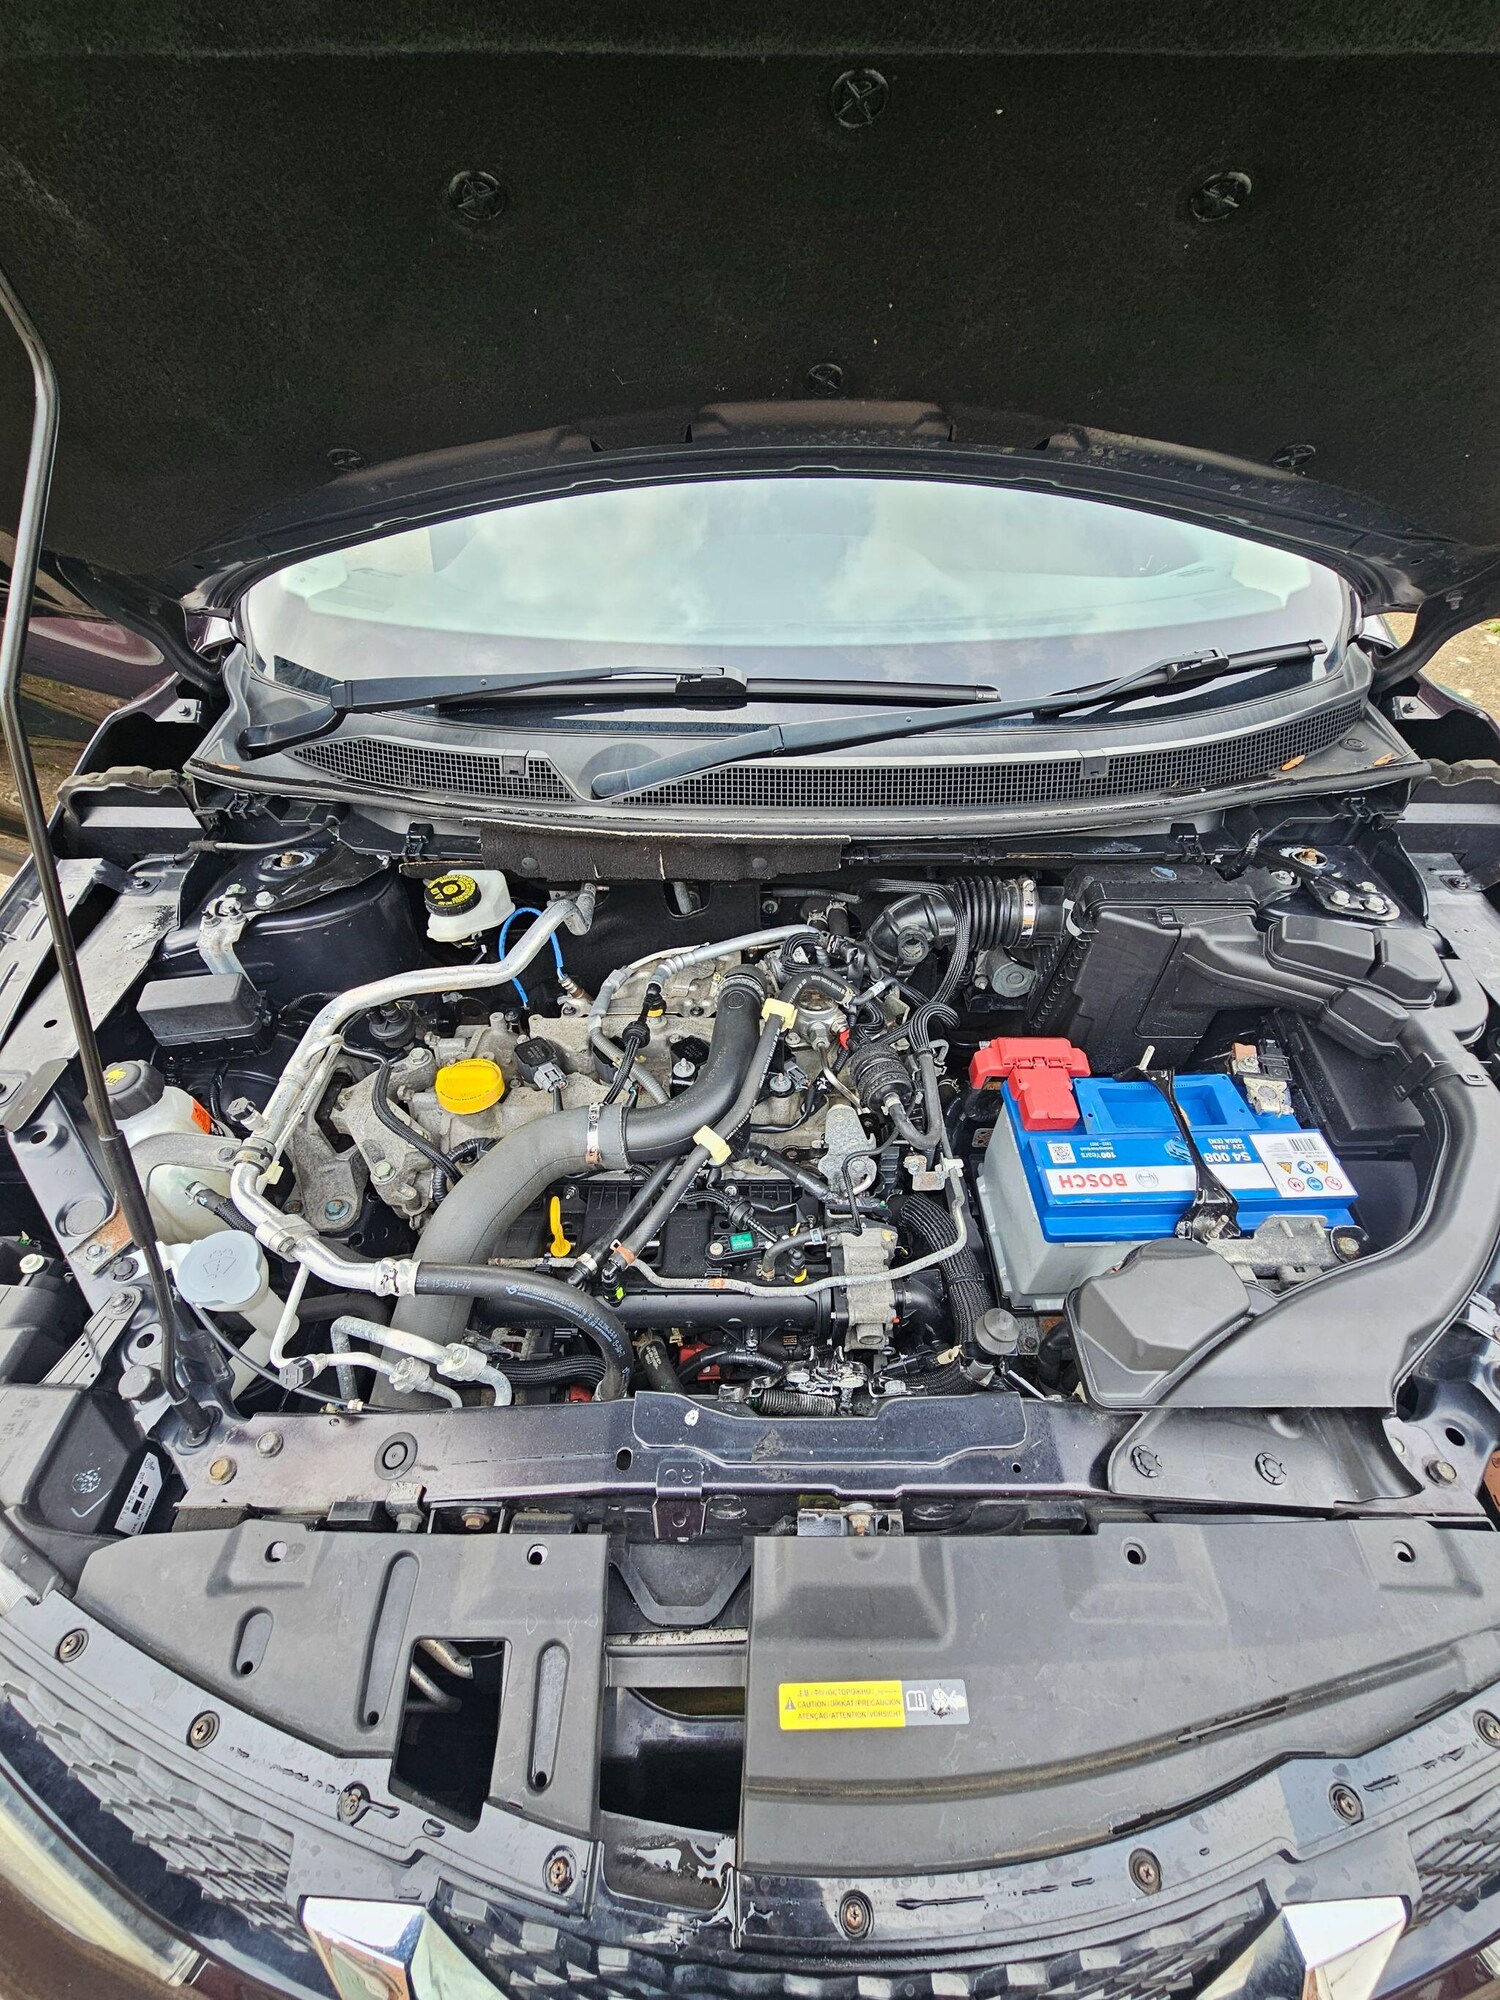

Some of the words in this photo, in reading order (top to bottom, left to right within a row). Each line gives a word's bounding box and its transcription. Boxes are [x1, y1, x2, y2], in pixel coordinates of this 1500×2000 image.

[1203, 1152, 1231, 1163] 008
[1231, 1151, 1251, 1162] S4
[1058, 1173, 1128, 1189] BOSCH
